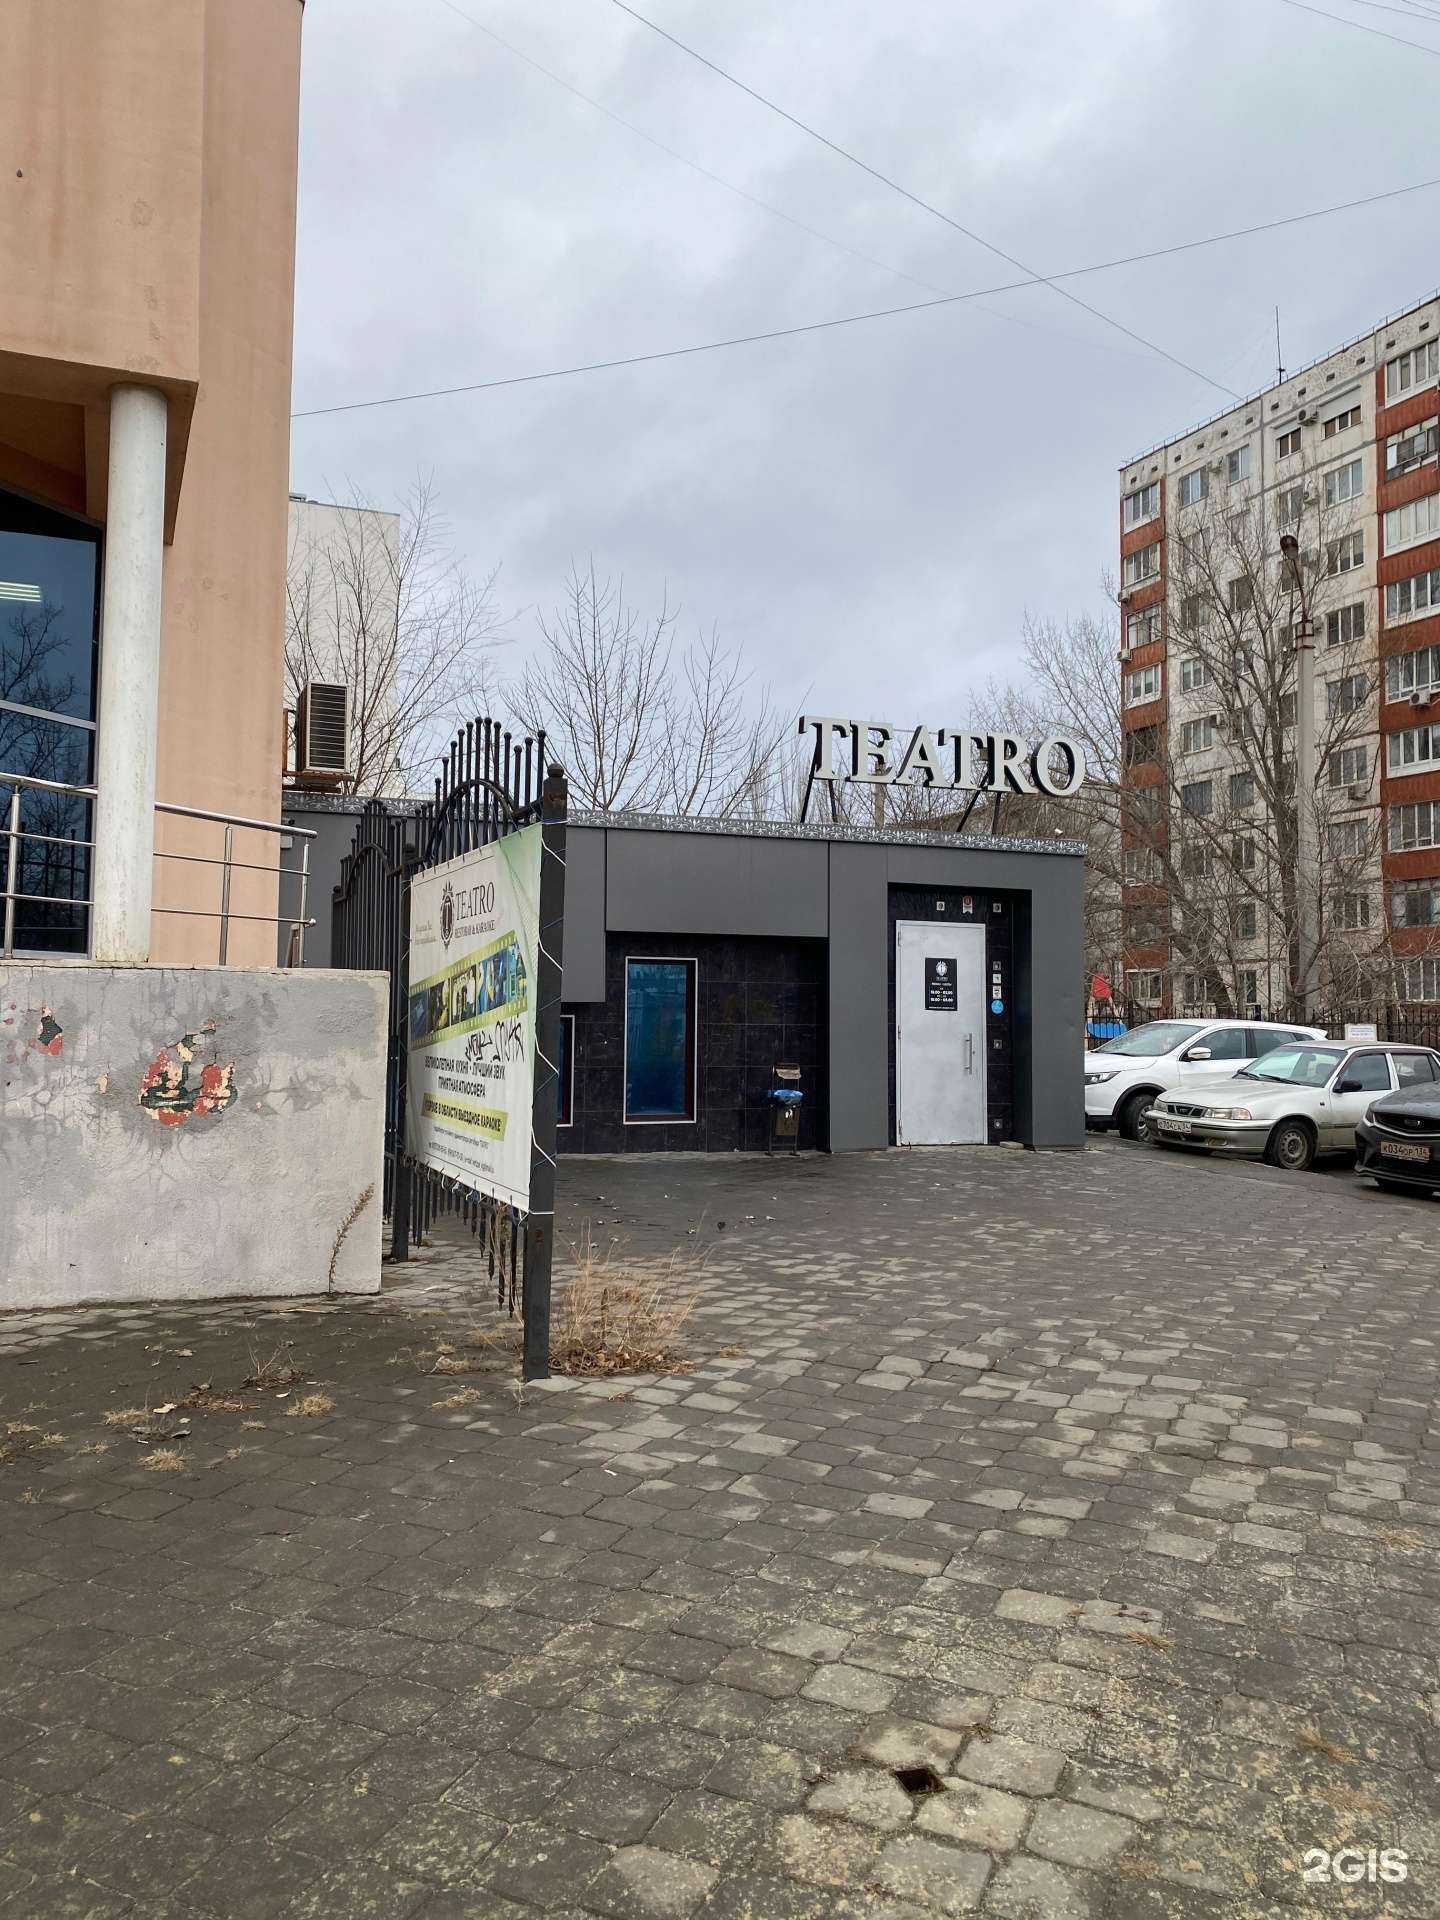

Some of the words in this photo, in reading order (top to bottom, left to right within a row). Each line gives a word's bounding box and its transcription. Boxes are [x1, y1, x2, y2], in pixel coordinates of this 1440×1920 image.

[799, 715, 1087, 797] TEATRO
[456, 882, 495, 920] TEATRO
[458, 1078, 486, 1098] АТМОСФЕРА
